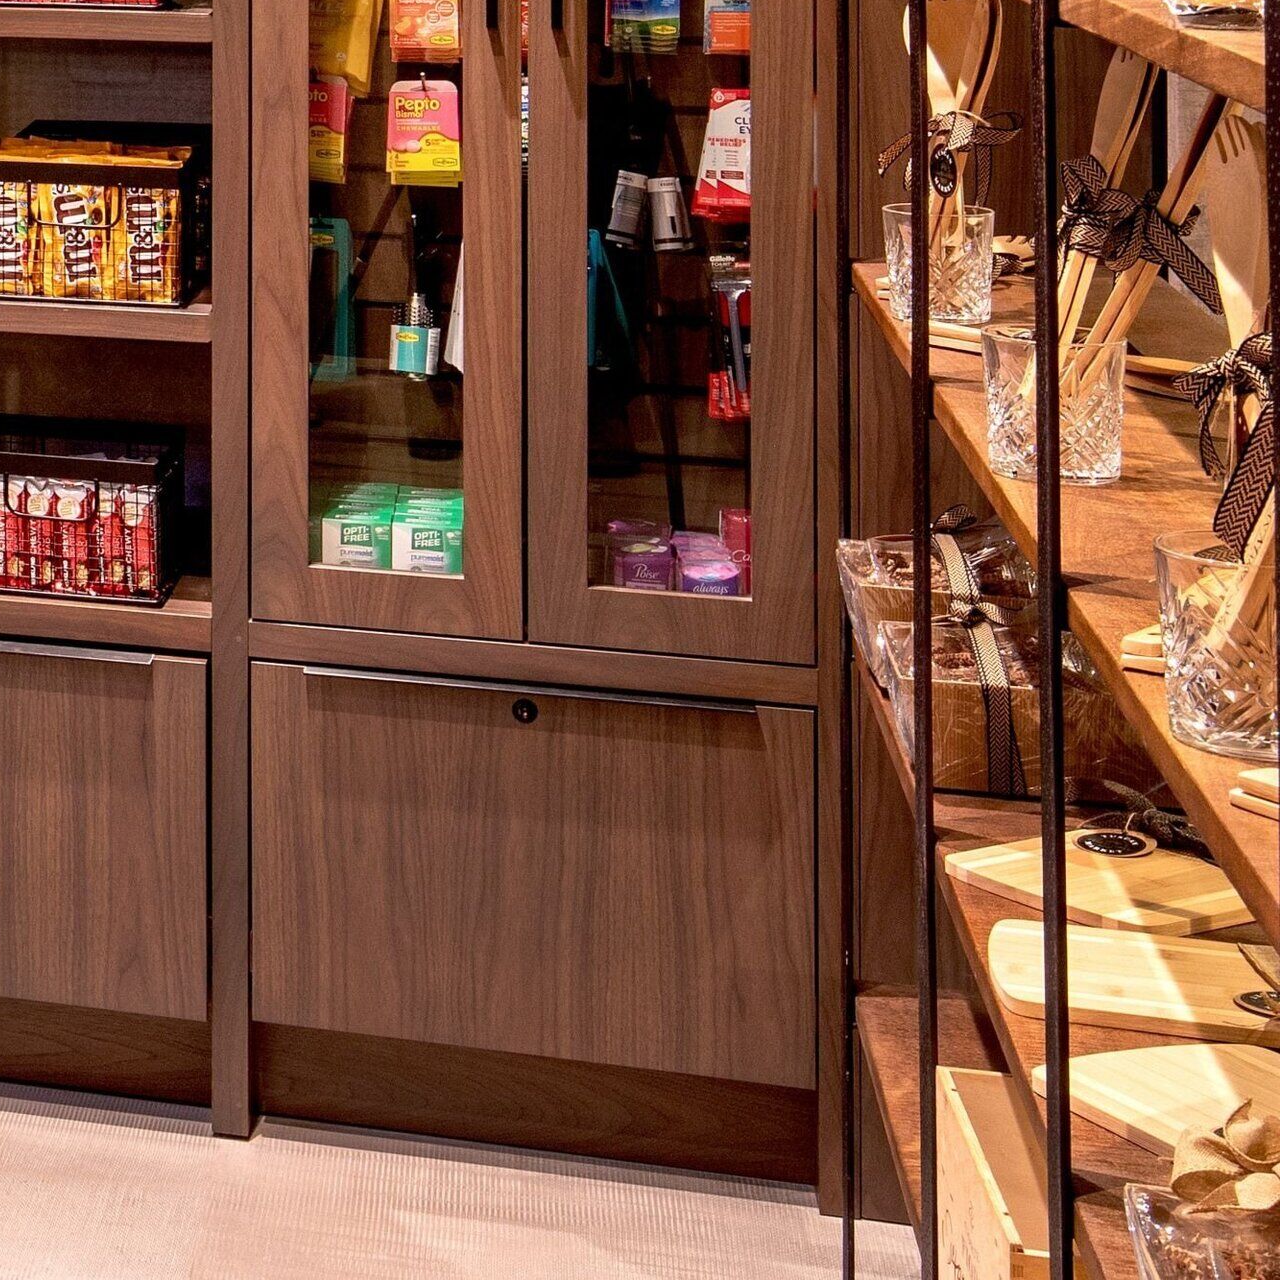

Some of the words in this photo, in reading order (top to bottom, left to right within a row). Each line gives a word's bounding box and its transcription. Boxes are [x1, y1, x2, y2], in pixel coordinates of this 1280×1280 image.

[395, 97, 440, 118] Pepto
[395, 110, 424, 119] Bismol
[709, 255, 735, 263] Gillette
[343, 525, 369, 535] OPTI-
[344, 534, 370, 543] FREE
[414, 531, 440, 540] OPTI-
[415, 539, 440, 548] FREE
[633, 563, 659, 579] Poise
[693, 583, 729, 595] always
